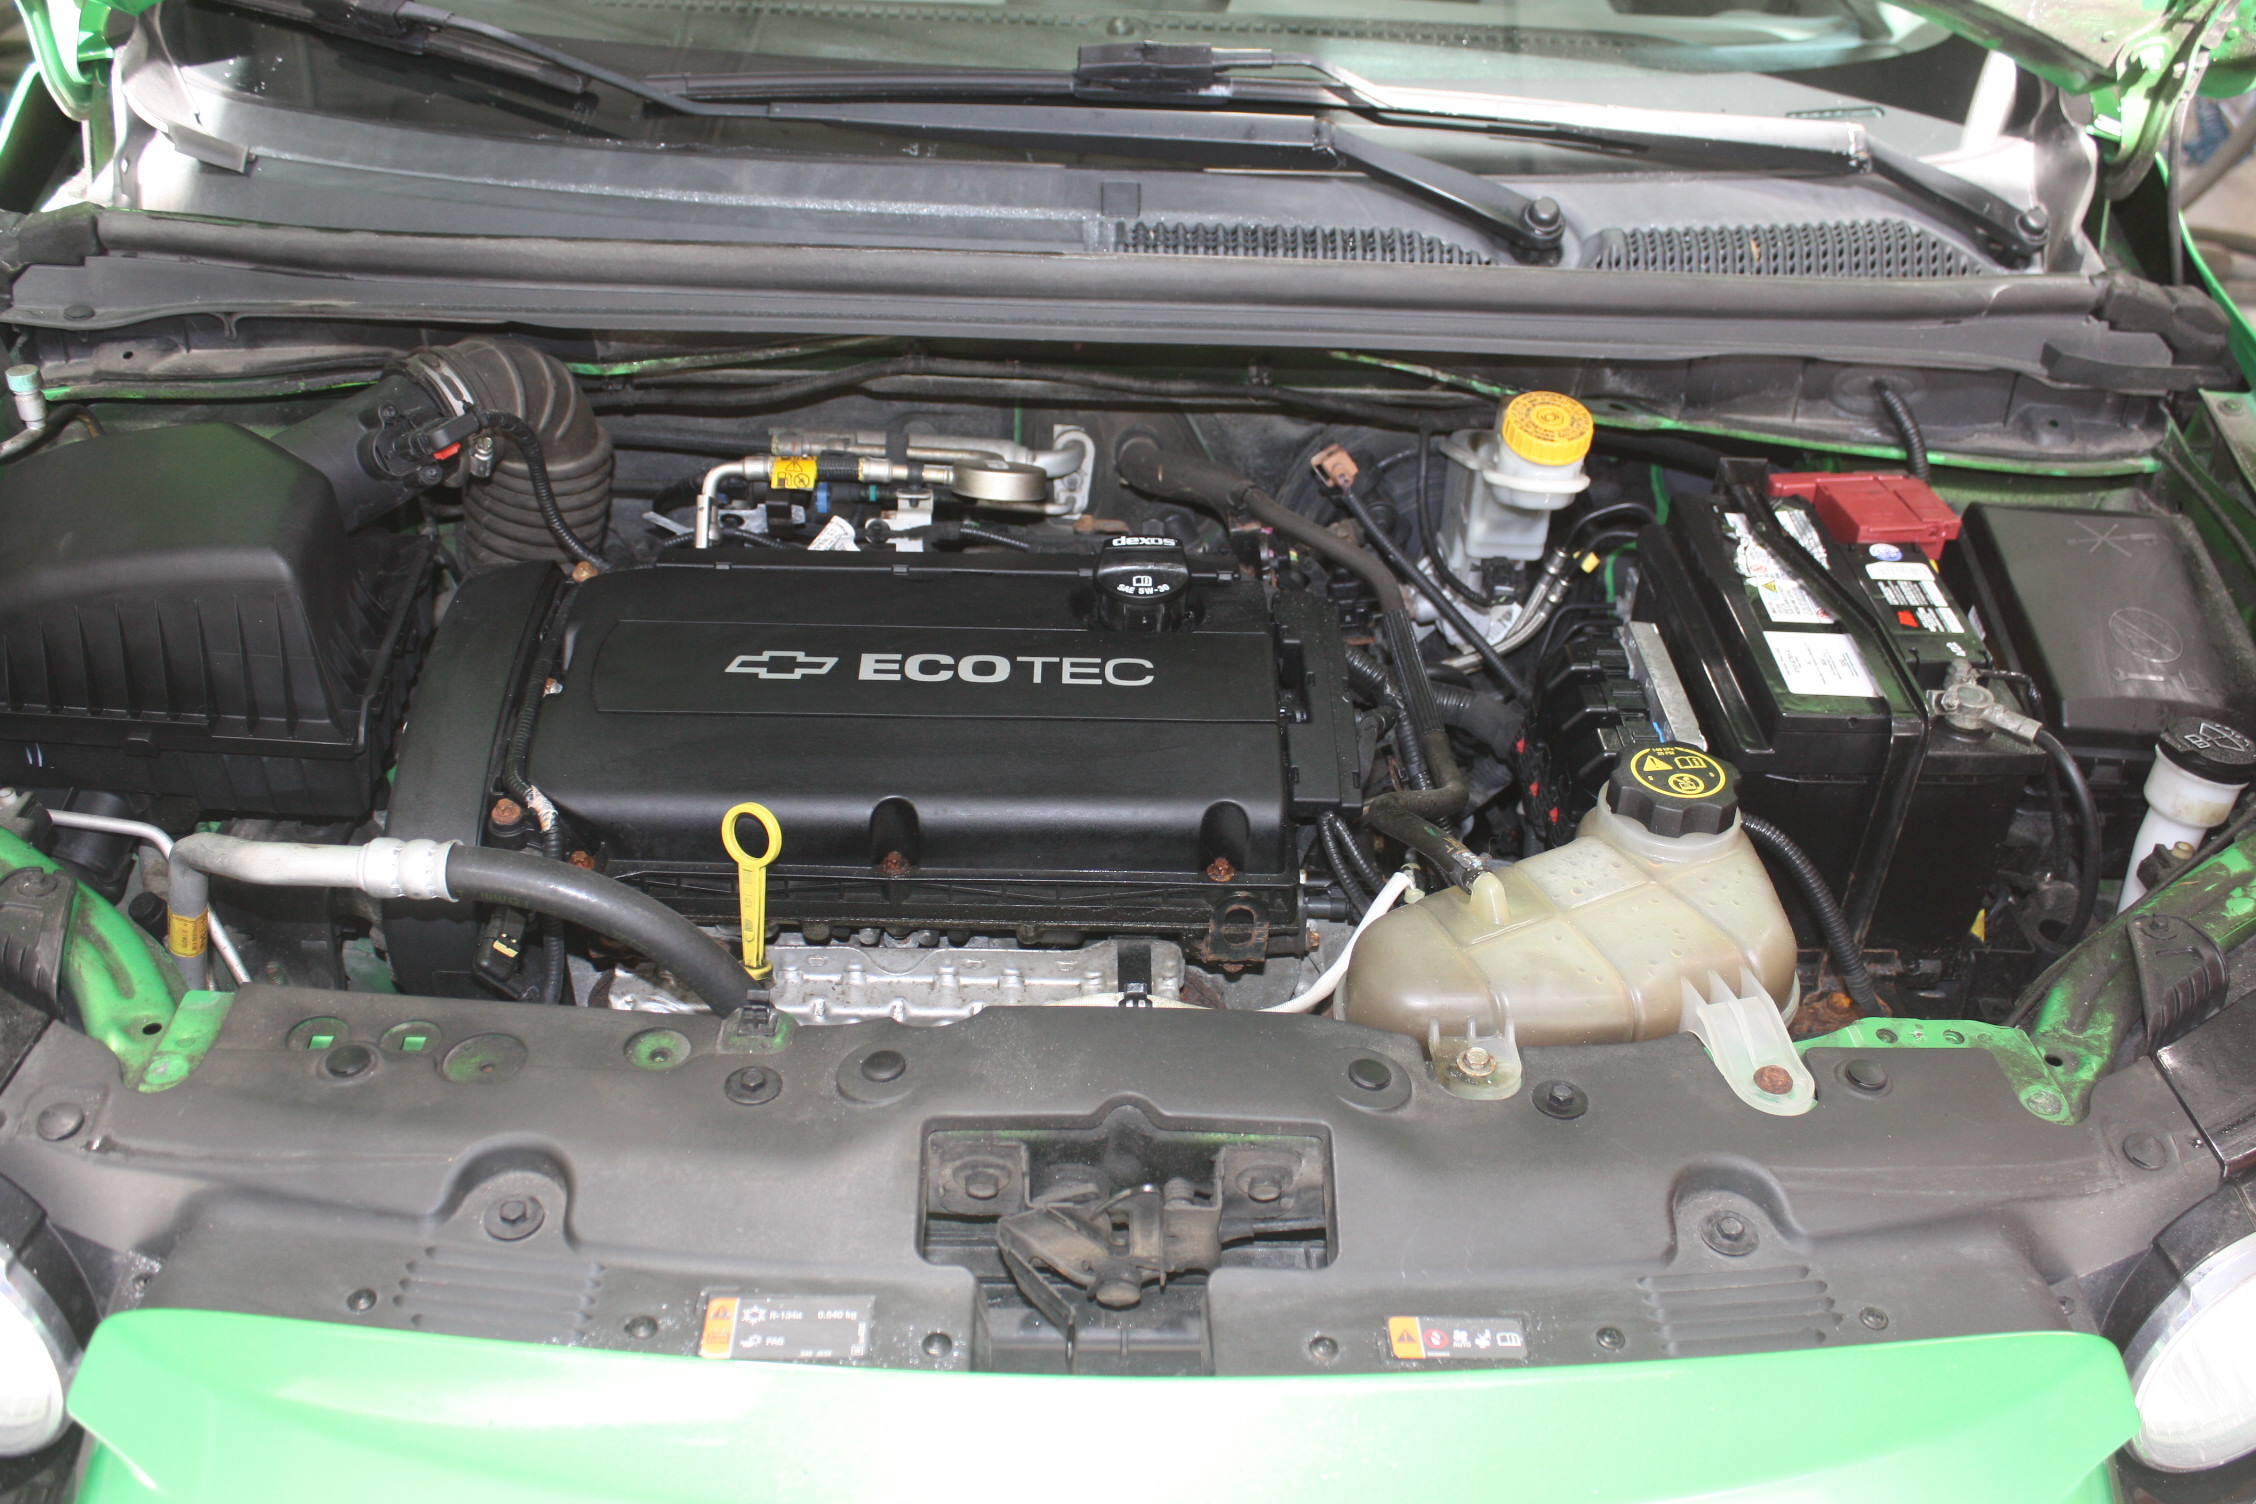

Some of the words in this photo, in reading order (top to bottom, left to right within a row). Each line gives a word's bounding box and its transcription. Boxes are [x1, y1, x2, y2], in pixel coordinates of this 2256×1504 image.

[1112, 535, 1176, 546] dexos
[1116, 583, 1135, 594] SAE
[1138, 583, 1170, 595] 5W-30
[858, 653, 1155, 686] ECOTEC
[769, 1310, 803, 1320] R-134a
[765, 1336, 785, 1346] PAG
